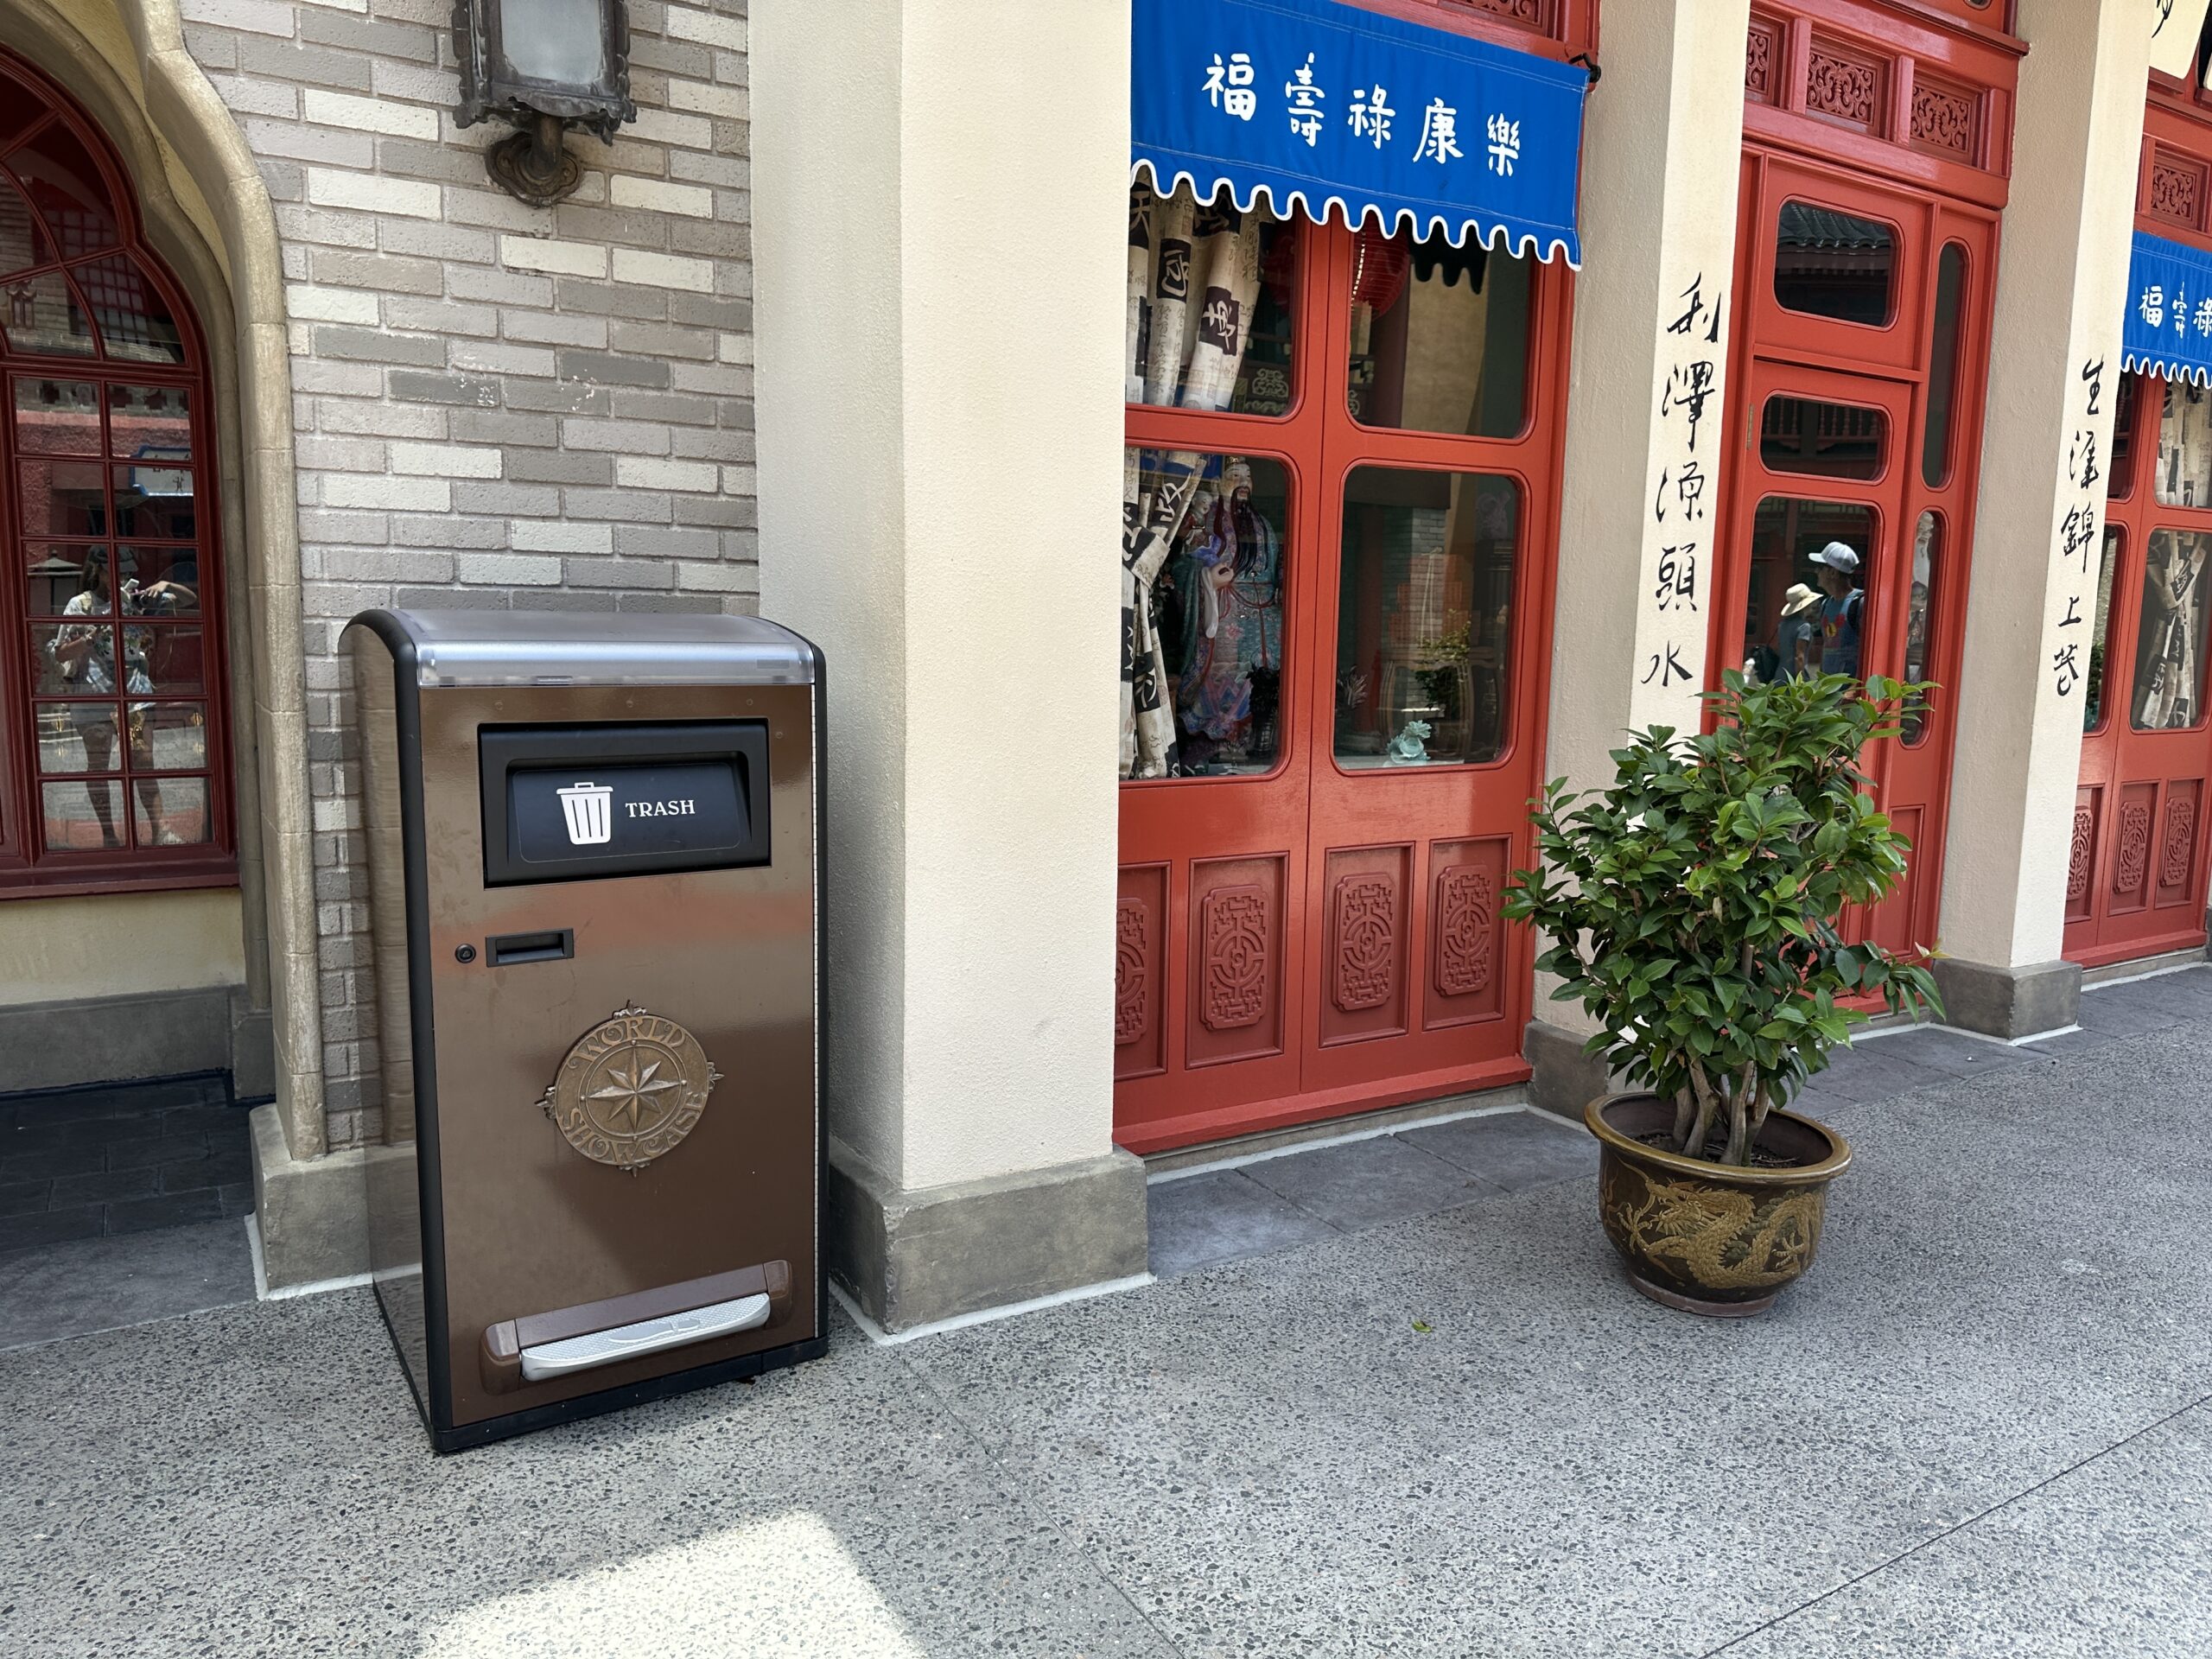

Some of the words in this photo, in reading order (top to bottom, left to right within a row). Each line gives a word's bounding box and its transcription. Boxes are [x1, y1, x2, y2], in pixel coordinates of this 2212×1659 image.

[625, 799, 696, 817] TRASH
[567, 1015, 686, 1070] WORLD
[559, 1090, 707, 1163] SHOWCASE
